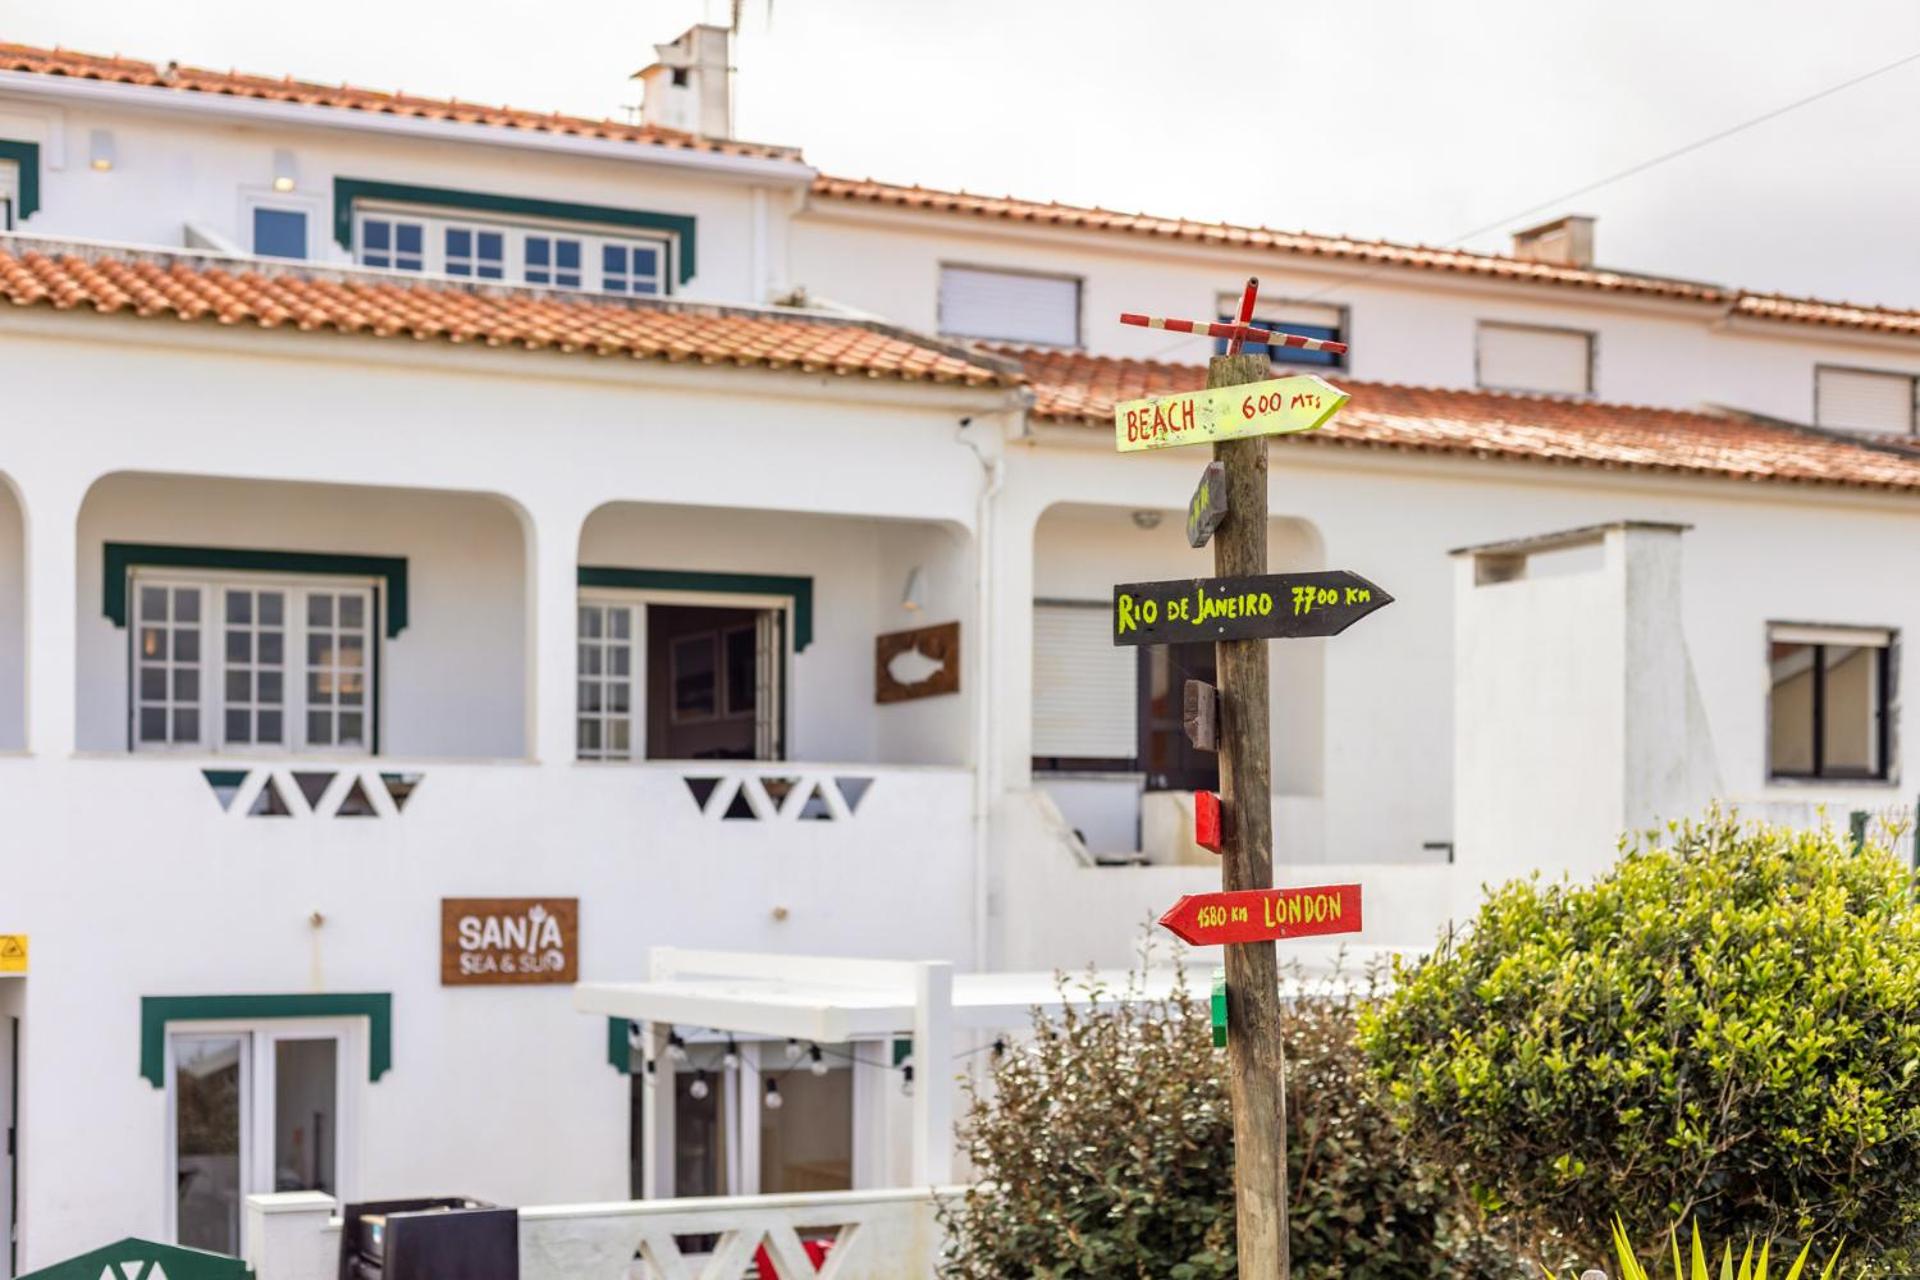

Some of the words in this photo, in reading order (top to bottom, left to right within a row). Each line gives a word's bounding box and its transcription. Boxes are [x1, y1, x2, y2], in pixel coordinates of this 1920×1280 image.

[1127, 399, 1195, 443] BEACH
[1242, 392, 1282, 420] 600
[1167, 598, 1189, 621] DE
[1192, 588, 1273, 625] JANEIRO
[1291, 585, 1338, 615] 7700
[1197, 905, 1227, 928] 1580
[1264, 892, 1341, 928] LONDON
[459, 952, 498, 975] SEA
[499, 953, 516, 973] &
